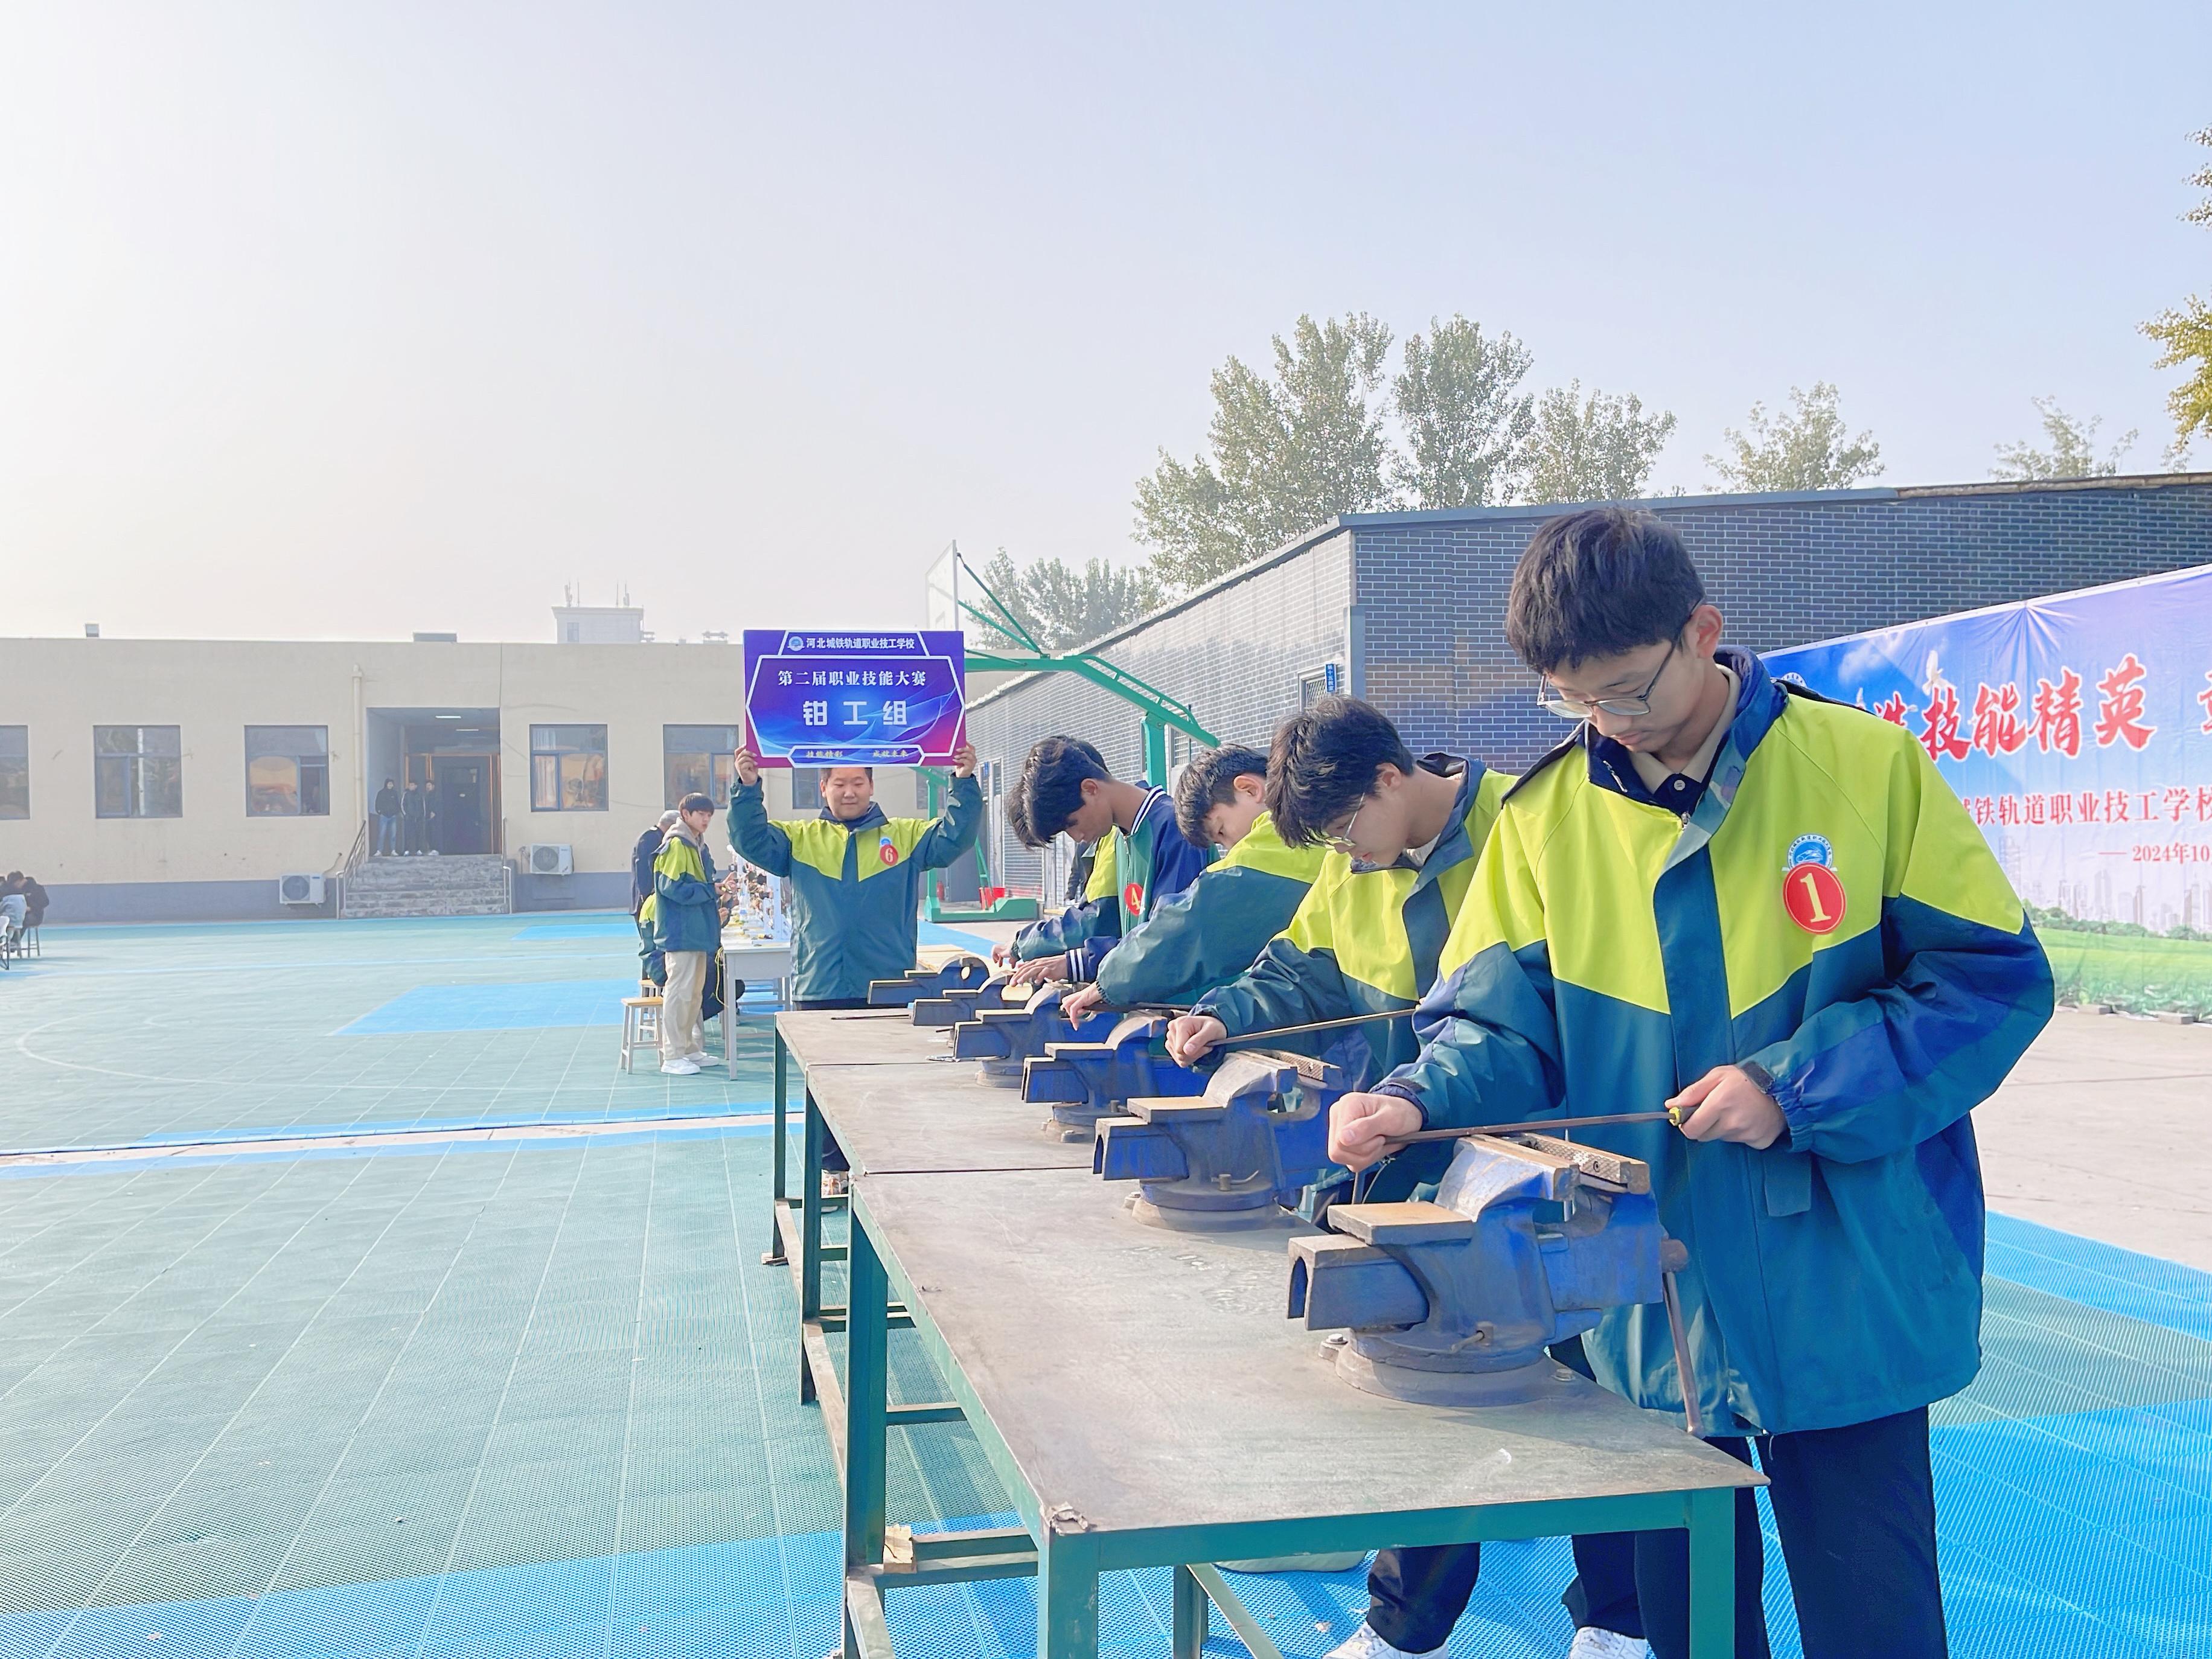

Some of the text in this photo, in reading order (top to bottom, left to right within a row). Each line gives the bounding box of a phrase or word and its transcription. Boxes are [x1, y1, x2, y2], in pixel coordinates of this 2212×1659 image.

[807, 638, 915, 649] 河北城铁轨道职业技工学校
[778, 671, 926, 686] 第二届职业技能大赛
[804, 701, 907, 726] 钳工组
[885, 847, 893, 863] 6
[1131, 887, 1140, 910] 4
[1800, 873, 1831, 922] 1
